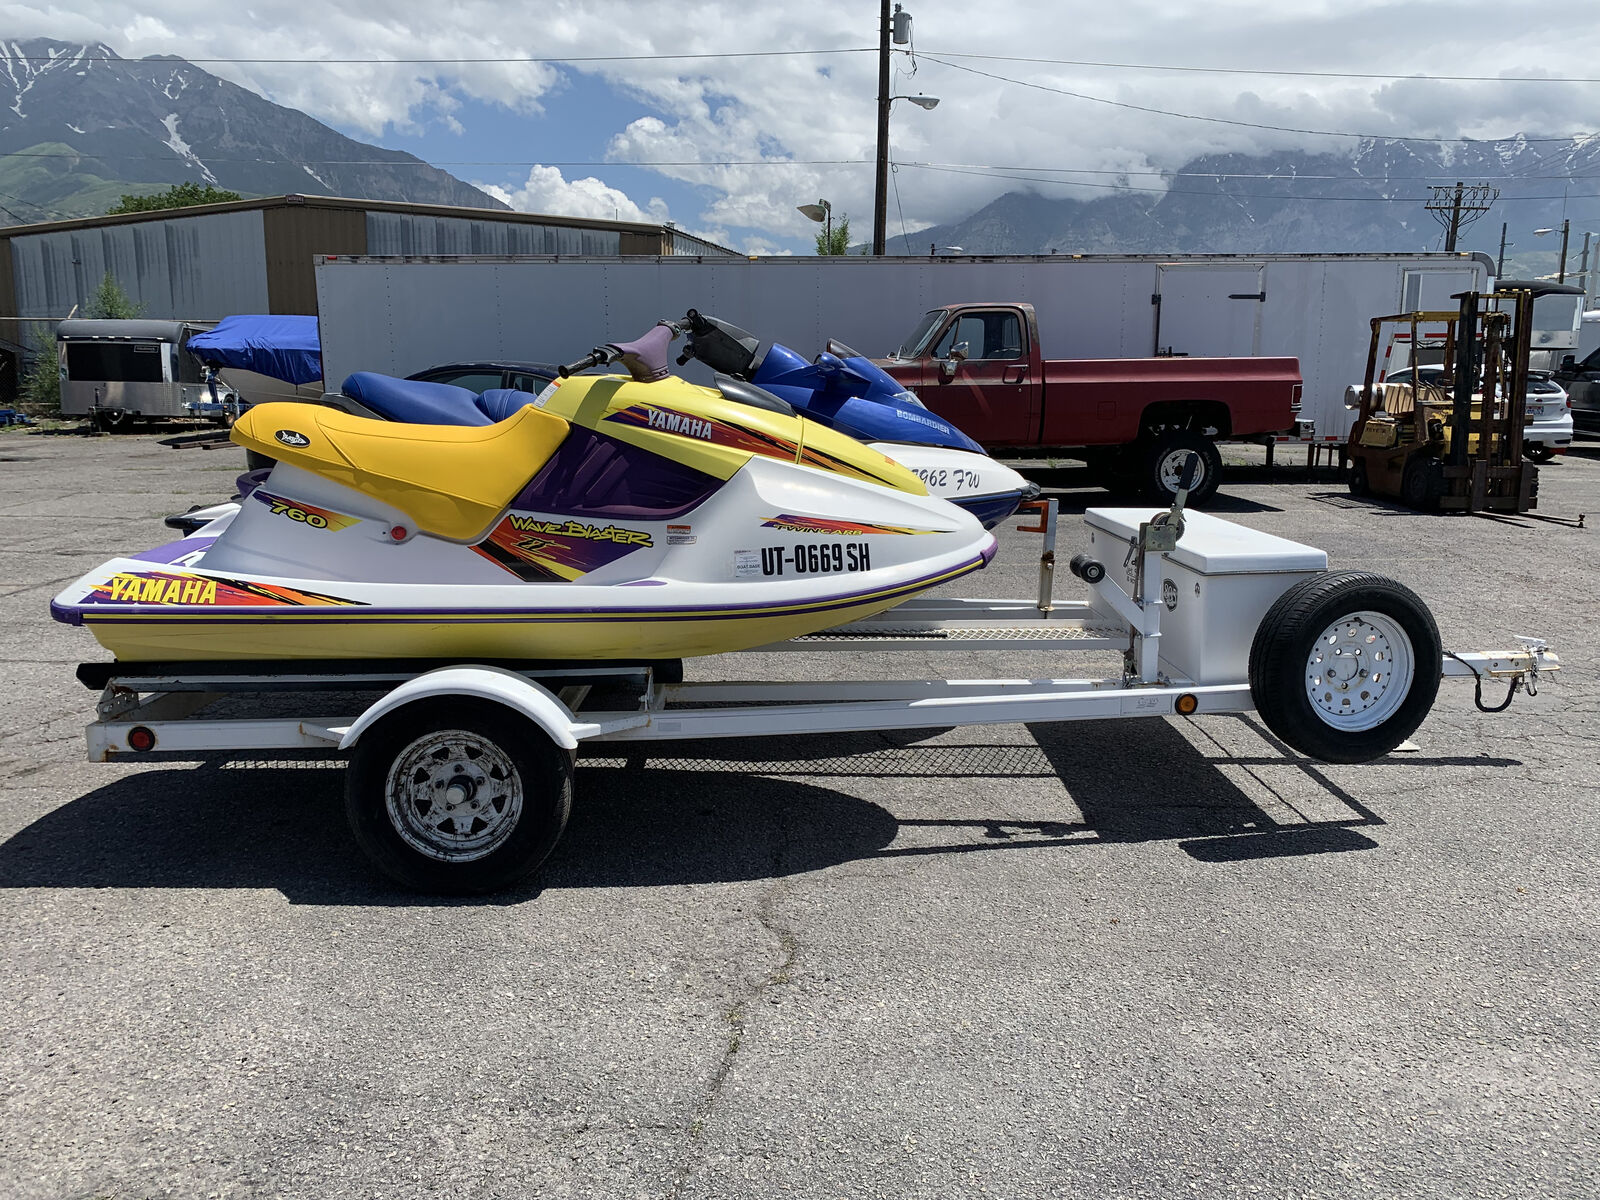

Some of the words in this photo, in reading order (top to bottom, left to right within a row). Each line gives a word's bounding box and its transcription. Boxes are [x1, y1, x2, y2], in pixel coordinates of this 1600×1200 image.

[647, 408, 713, 440] YAMAHA
[896, 408, 951, 435] BOMBARDIER
[952, 469, 980, 492] FW
[270, 500, 328, 529] 760
[761, 543, 844, 576] UT-0669
[846, 543, 871, 572] SH
[110, 577, 217, 604] YAMAHA
